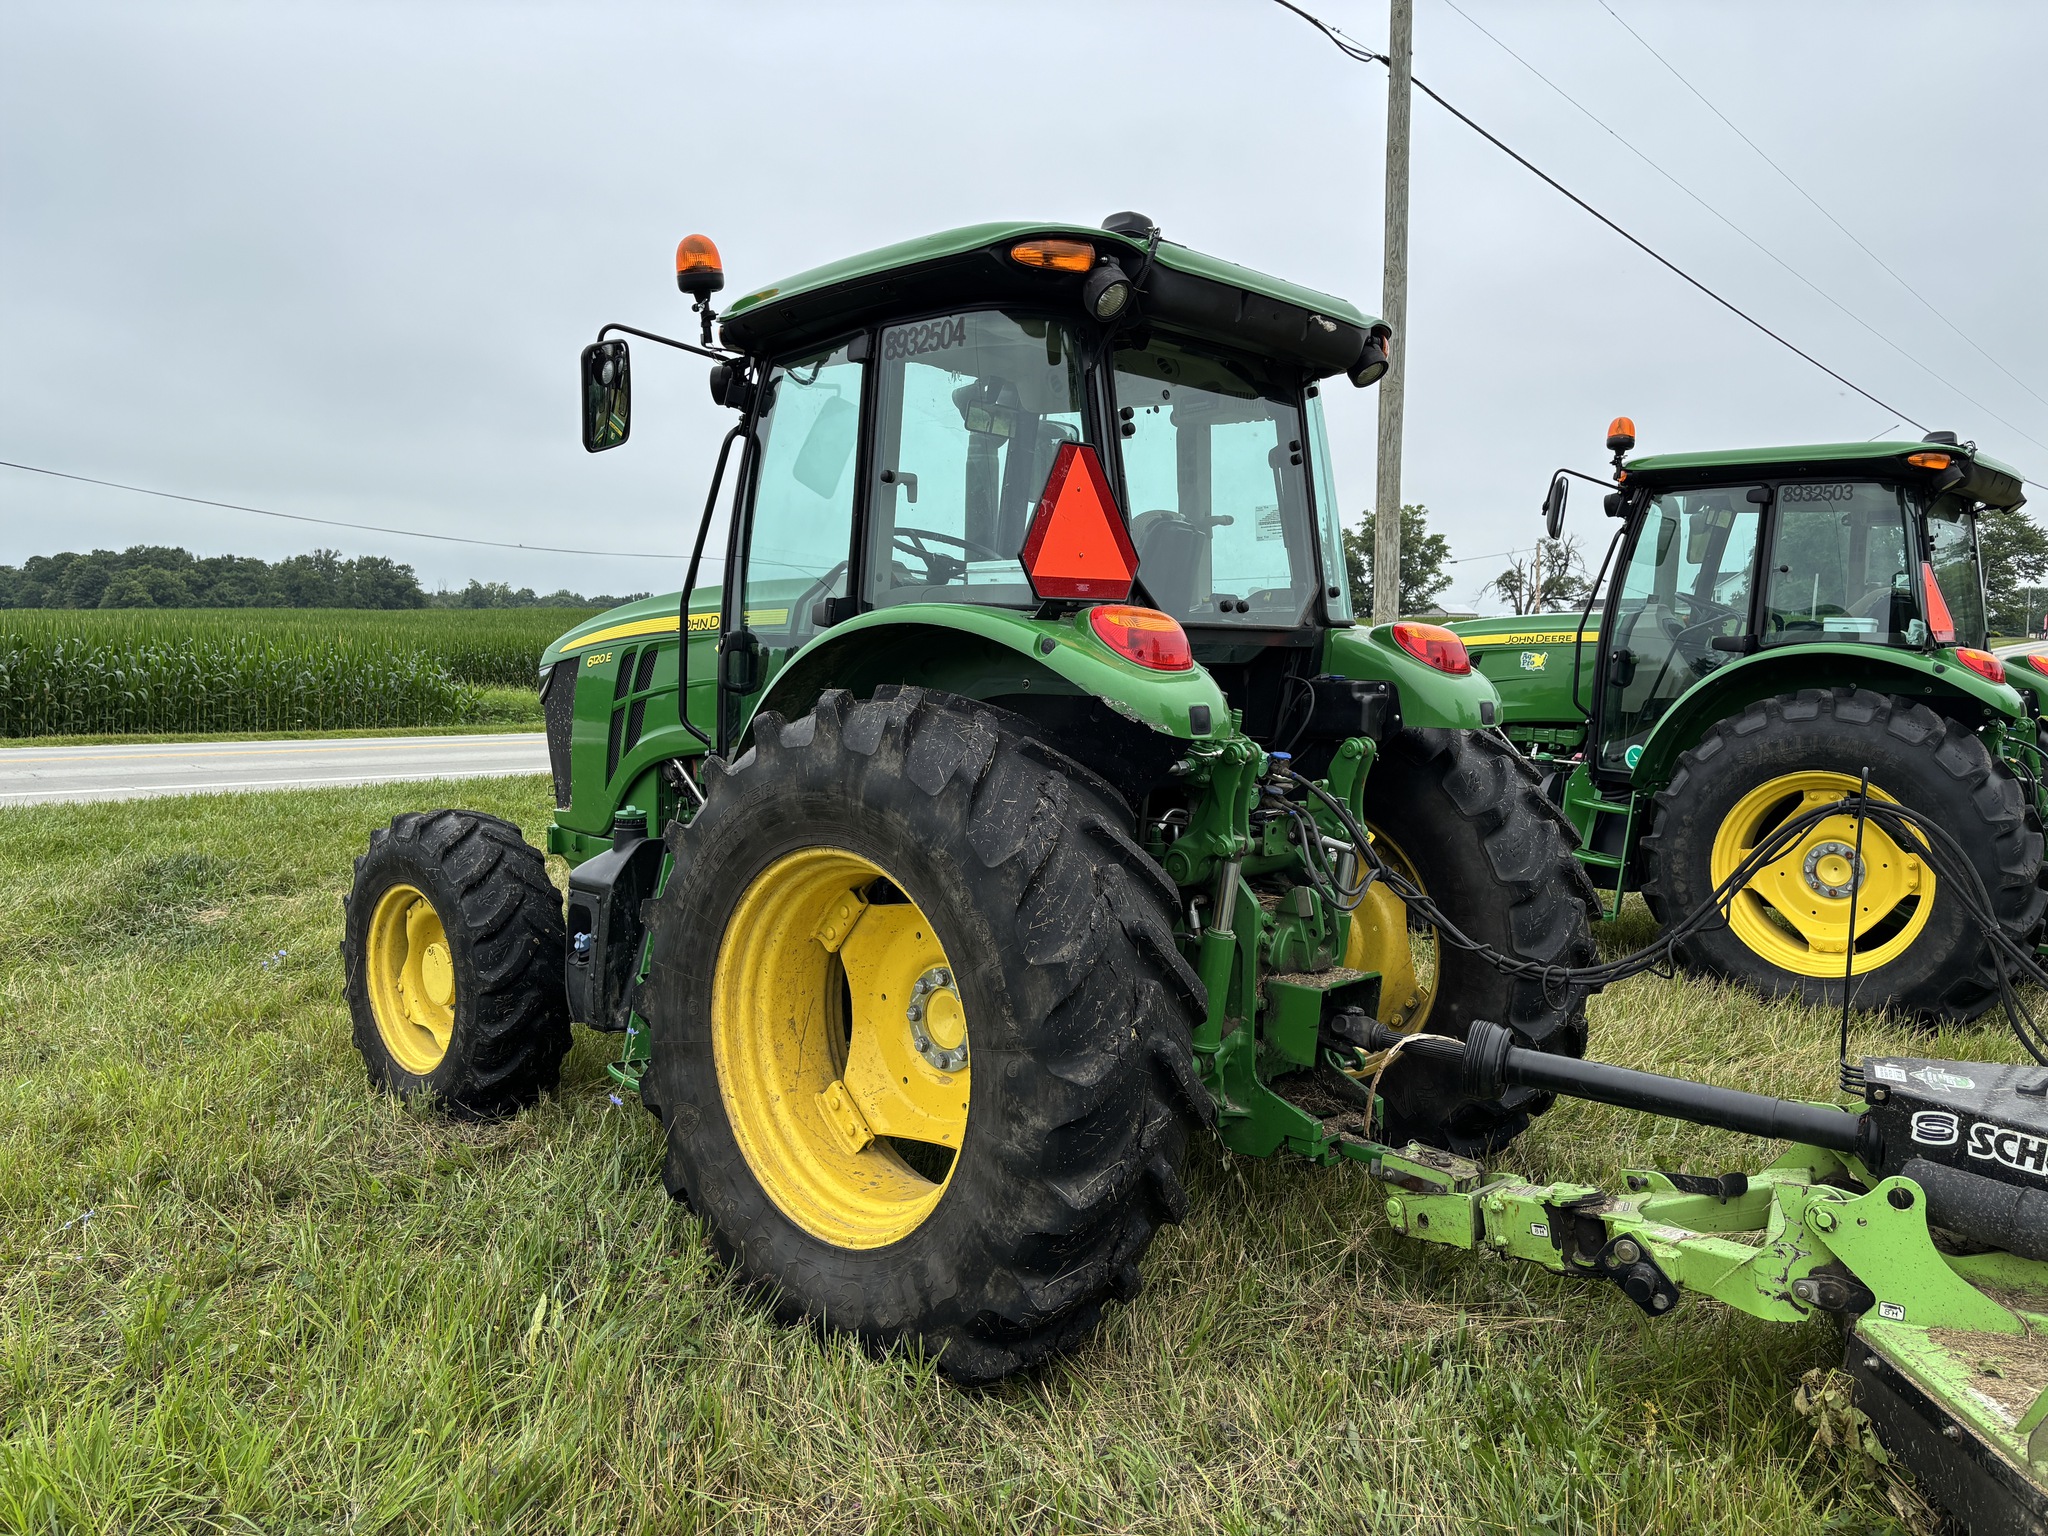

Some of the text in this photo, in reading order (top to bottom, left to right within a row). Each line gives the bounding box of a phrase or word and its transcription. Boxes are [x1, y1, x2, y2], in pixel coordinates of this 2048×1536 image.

[884, 316, 966, 361] 8932504
[1783, 484, 1854, 502] 8932503
[1505, 634, 1572, 644] JOHN DEERE
[1967, 1122, 2048, 1176] SCH
